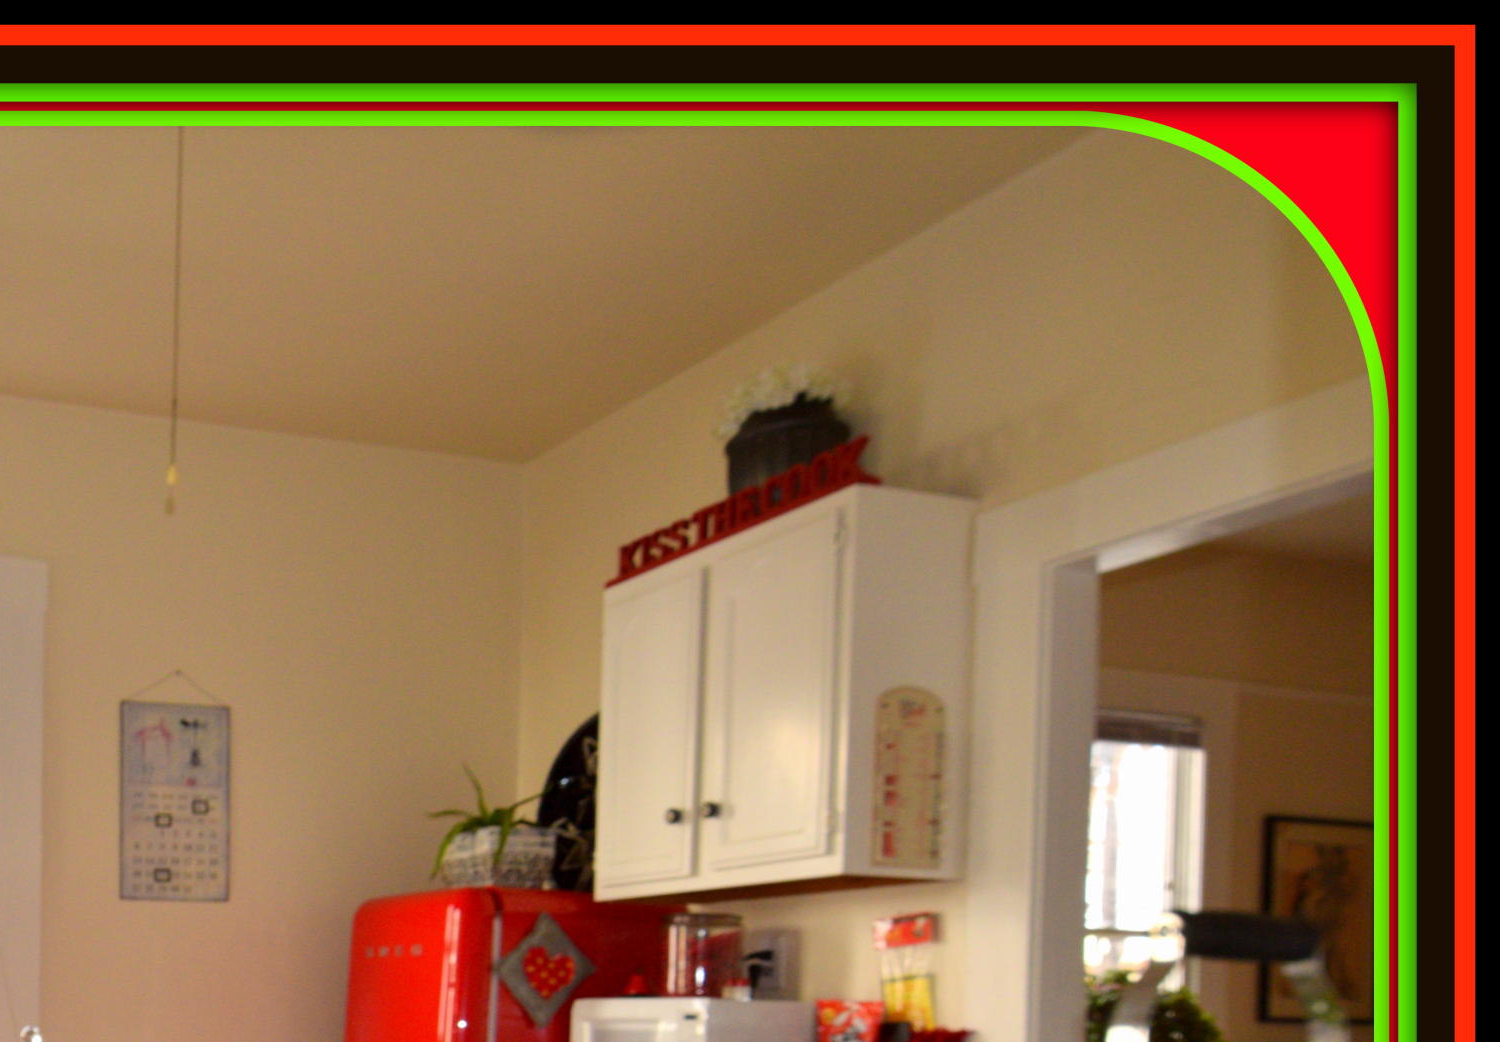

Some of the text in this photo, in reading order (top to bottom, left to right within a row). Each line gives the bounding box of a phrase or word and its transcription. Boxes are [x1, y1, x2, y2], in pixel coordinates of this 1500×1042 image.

[619, 436, 882, 575] KISS THE COOK
